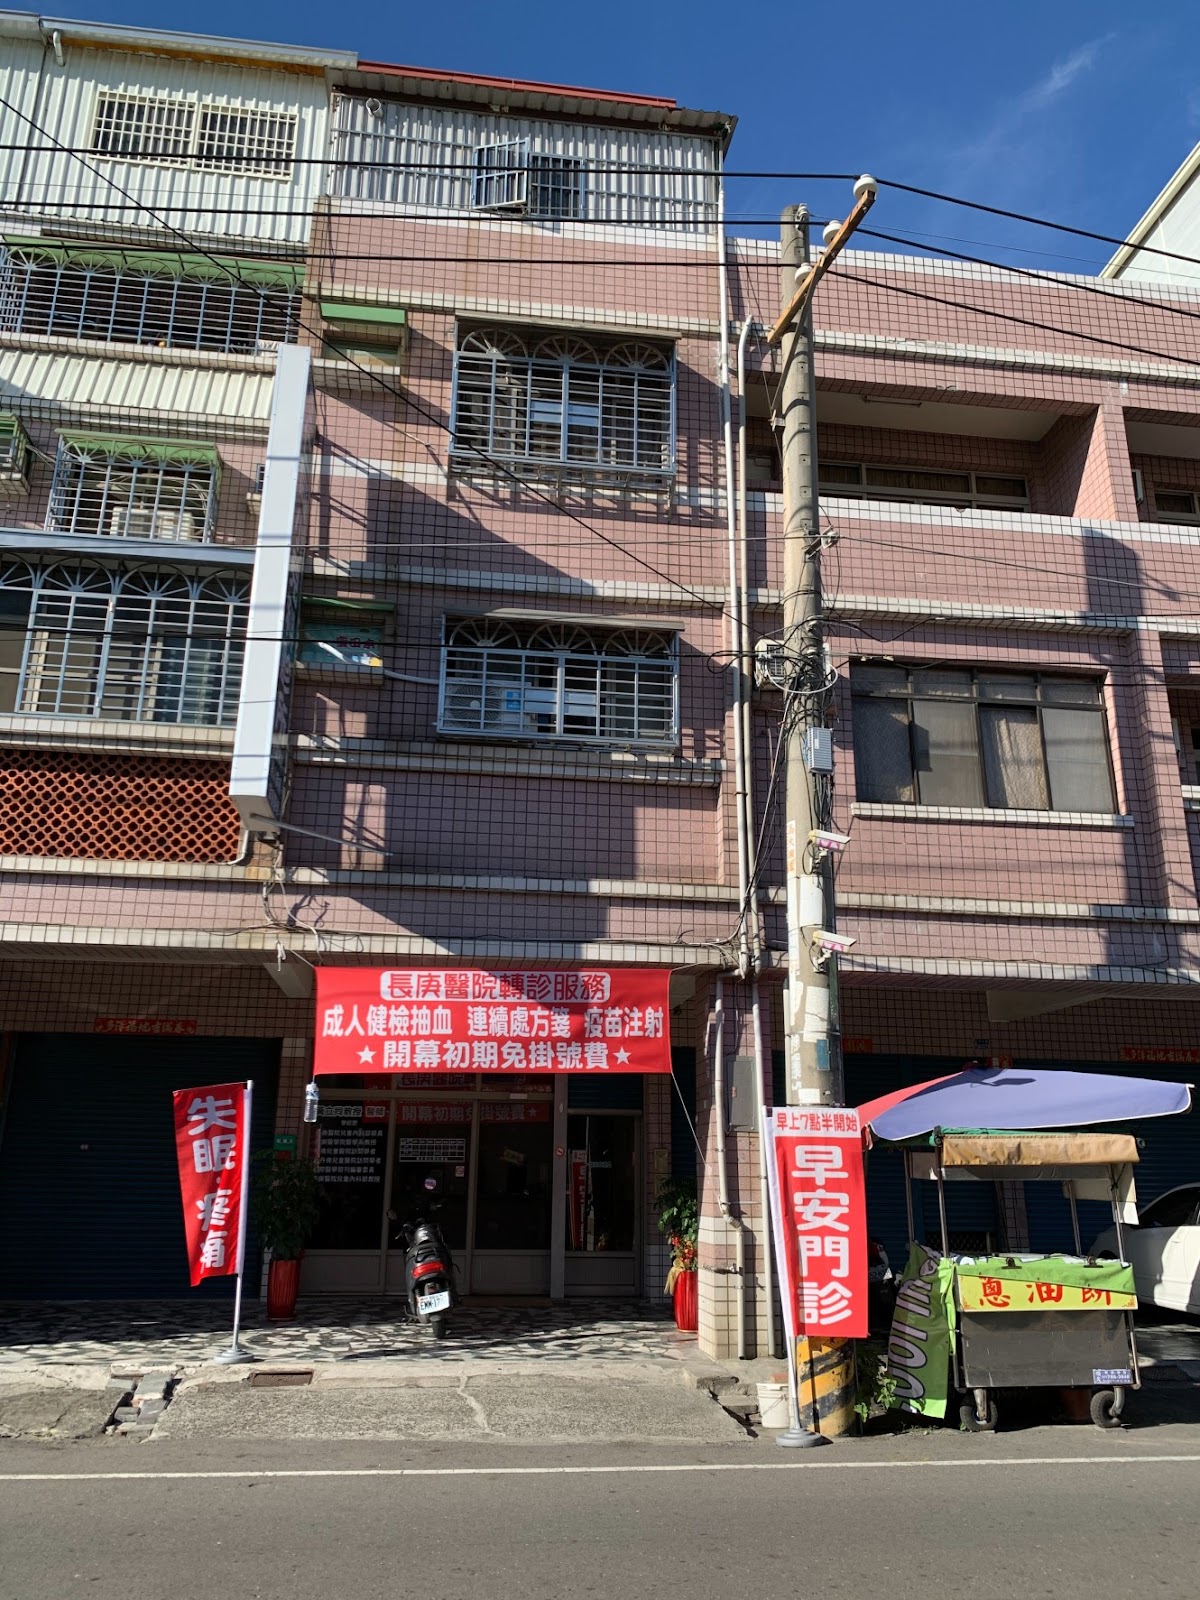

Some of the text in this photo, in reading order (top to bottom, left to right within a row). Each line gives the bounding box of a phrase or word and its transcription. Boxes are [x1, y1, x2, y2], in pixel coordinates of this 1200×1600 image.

[387, 973, 606, 1002] 長庚醫院轉診服務
[322, 1004, 664, 1039] 成人健檢抽血 連續處方箋 疫苗注射
[383, 1040, 609, 1070] 開幕初期免掛號費
[791, 1145, 852, 1326] 早安門診
